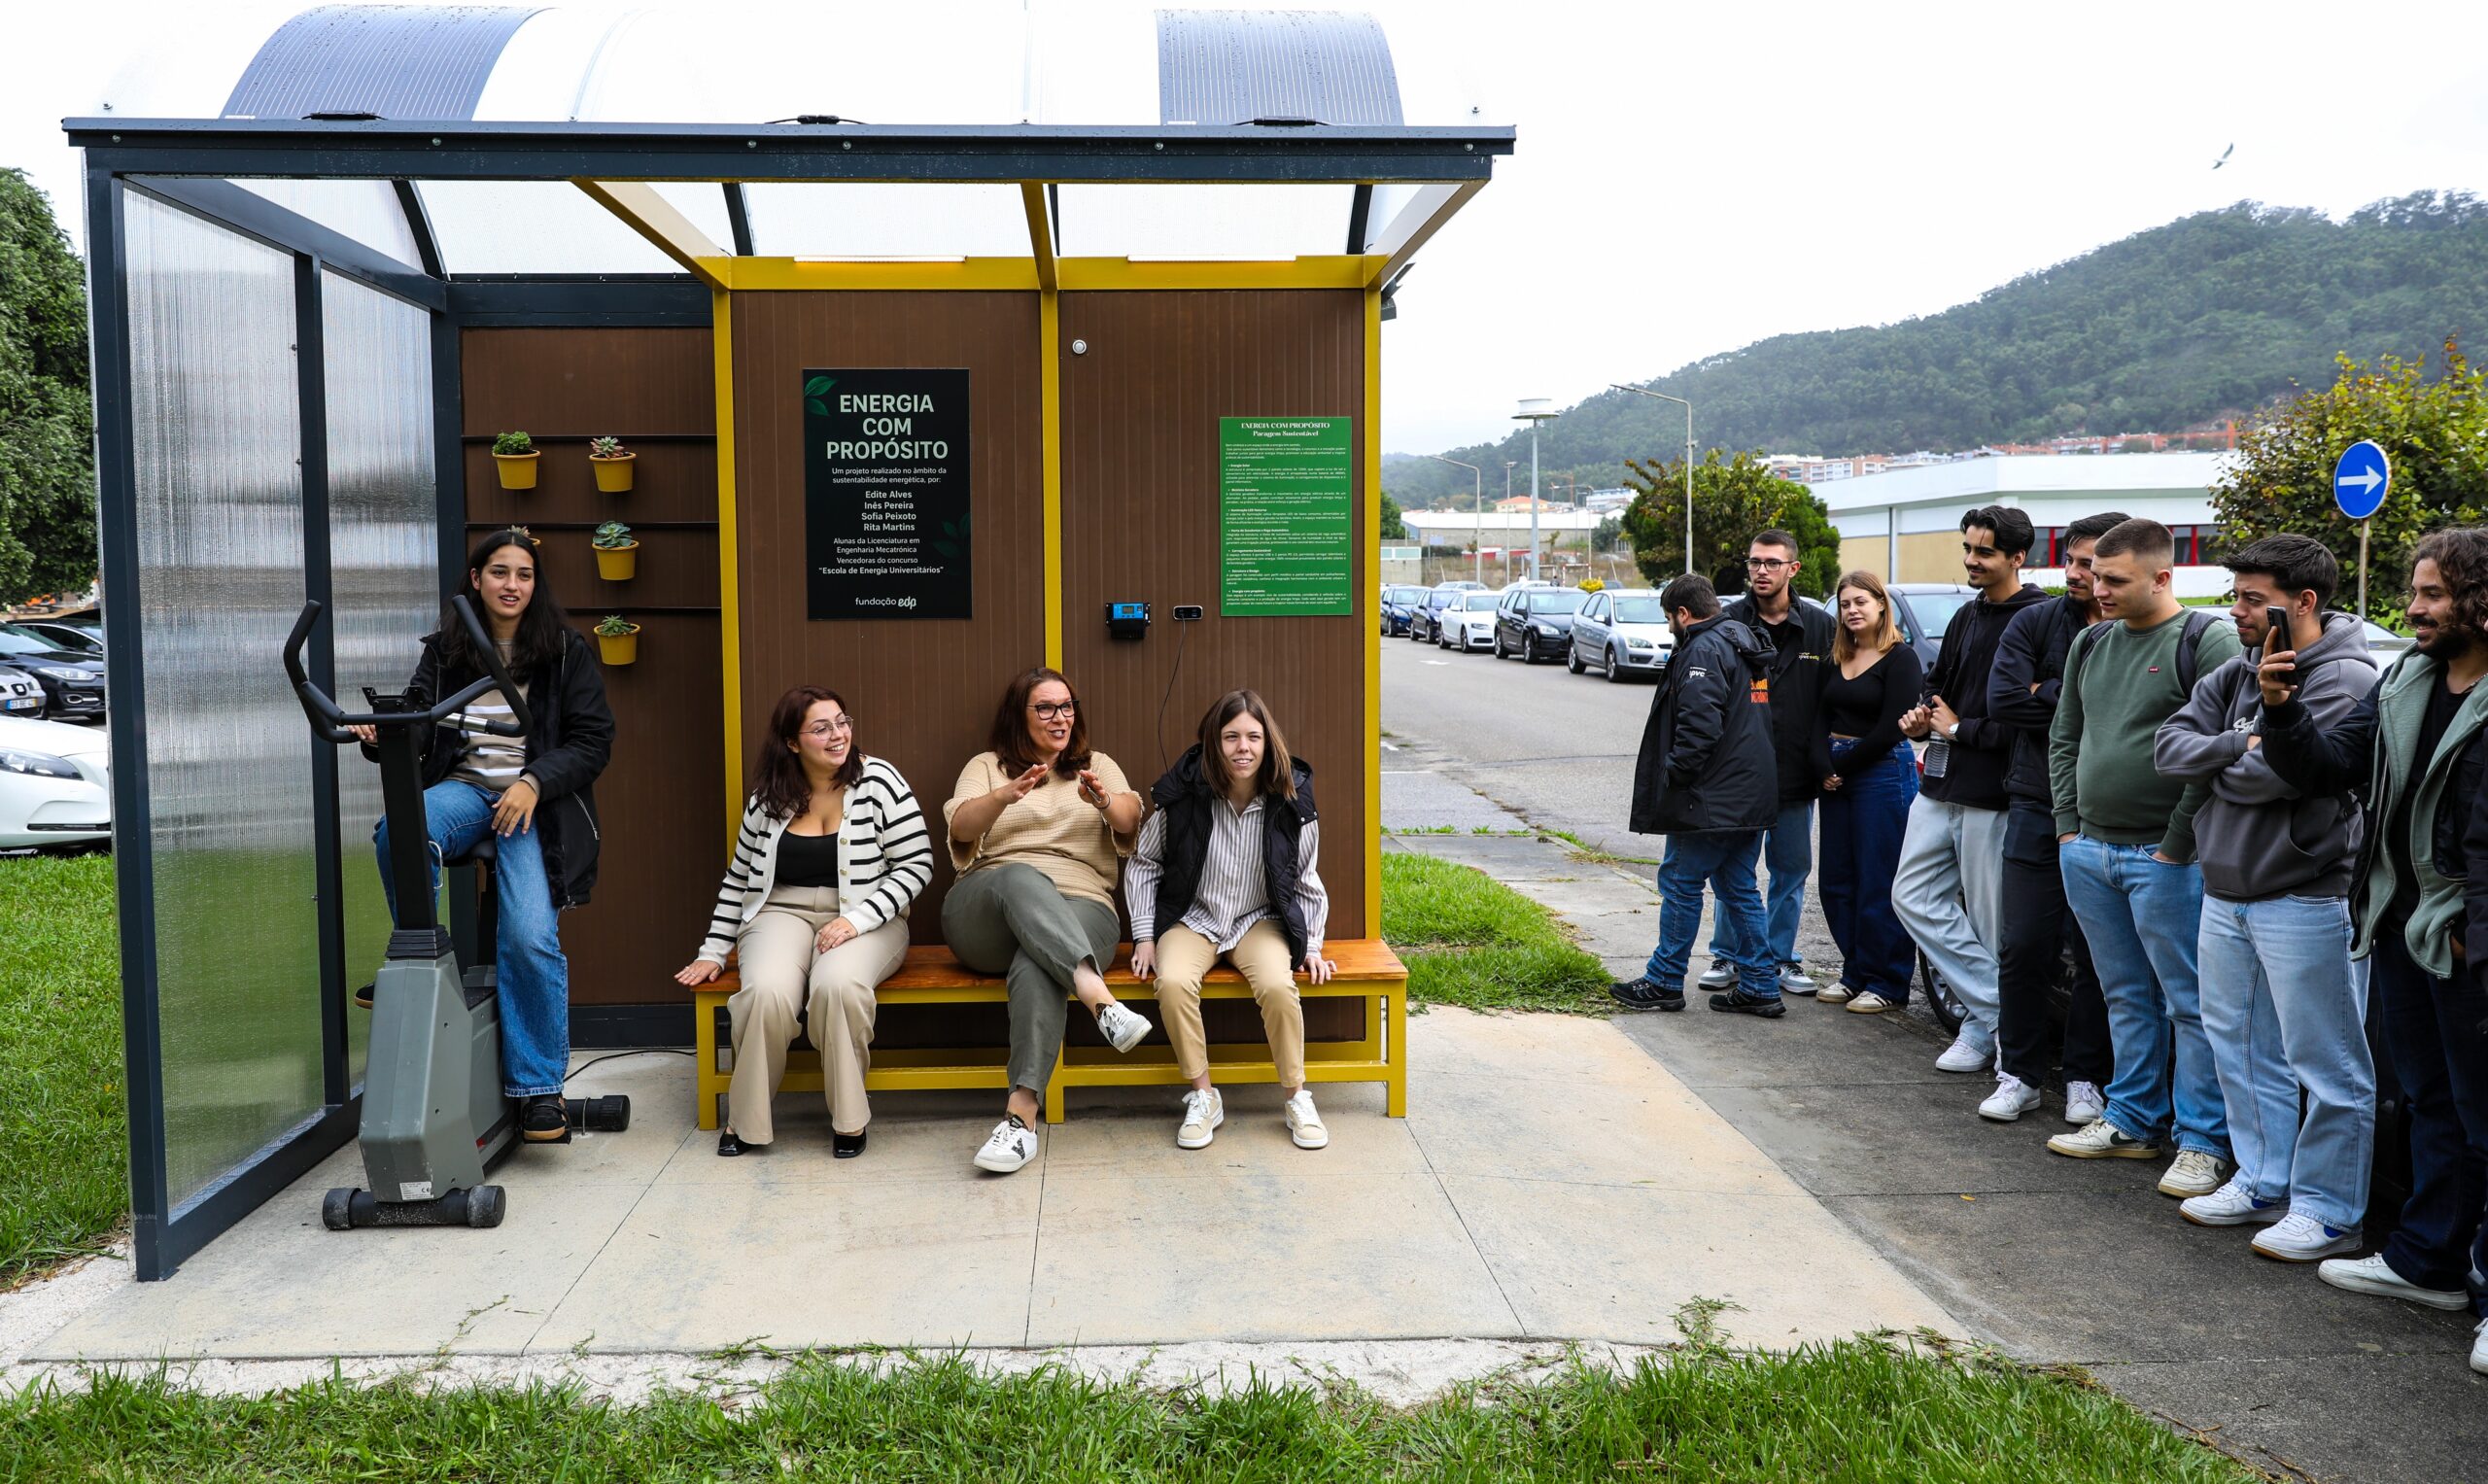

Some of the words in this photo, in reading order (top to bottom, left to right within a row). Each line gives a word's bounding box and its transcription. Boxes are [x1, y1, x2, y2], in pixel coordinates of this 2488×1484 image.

[840, 394, 935, 413] ENERGIA
[862, 417, 913, 436] COM
[826, 437, 949, 460] PROPÓSITO
[832, 466, 845, 475] Um
[845, 466, 870, 475] projeto
[871, 466, 902, 475] realizado
[902, 466, 912, 475] no
[913, 466, 937, 475] âmbito
[938, 466, 947, 475] da
[888, 476, 926, 485] energética,
[927, 476, 942, 485] por:
[865, 490, 887, 499] Edite
[889, 490, 913, 499] Alves
[884, 500, 915, 509] Pereira
[861, 511, 883, 521] Sofia
[885, 511, 916, 521] Peixoto
[863, 523, 881, 532] Rita
[882, 523, 916, 532] Martins
[836, 545, 875, 555] Engenharia
[847, 566, 858, 575] de
[859, 566, 888, 575] Energia
[855, 597, 897, 606] fundação
[898, 596, 916, 609] edp
